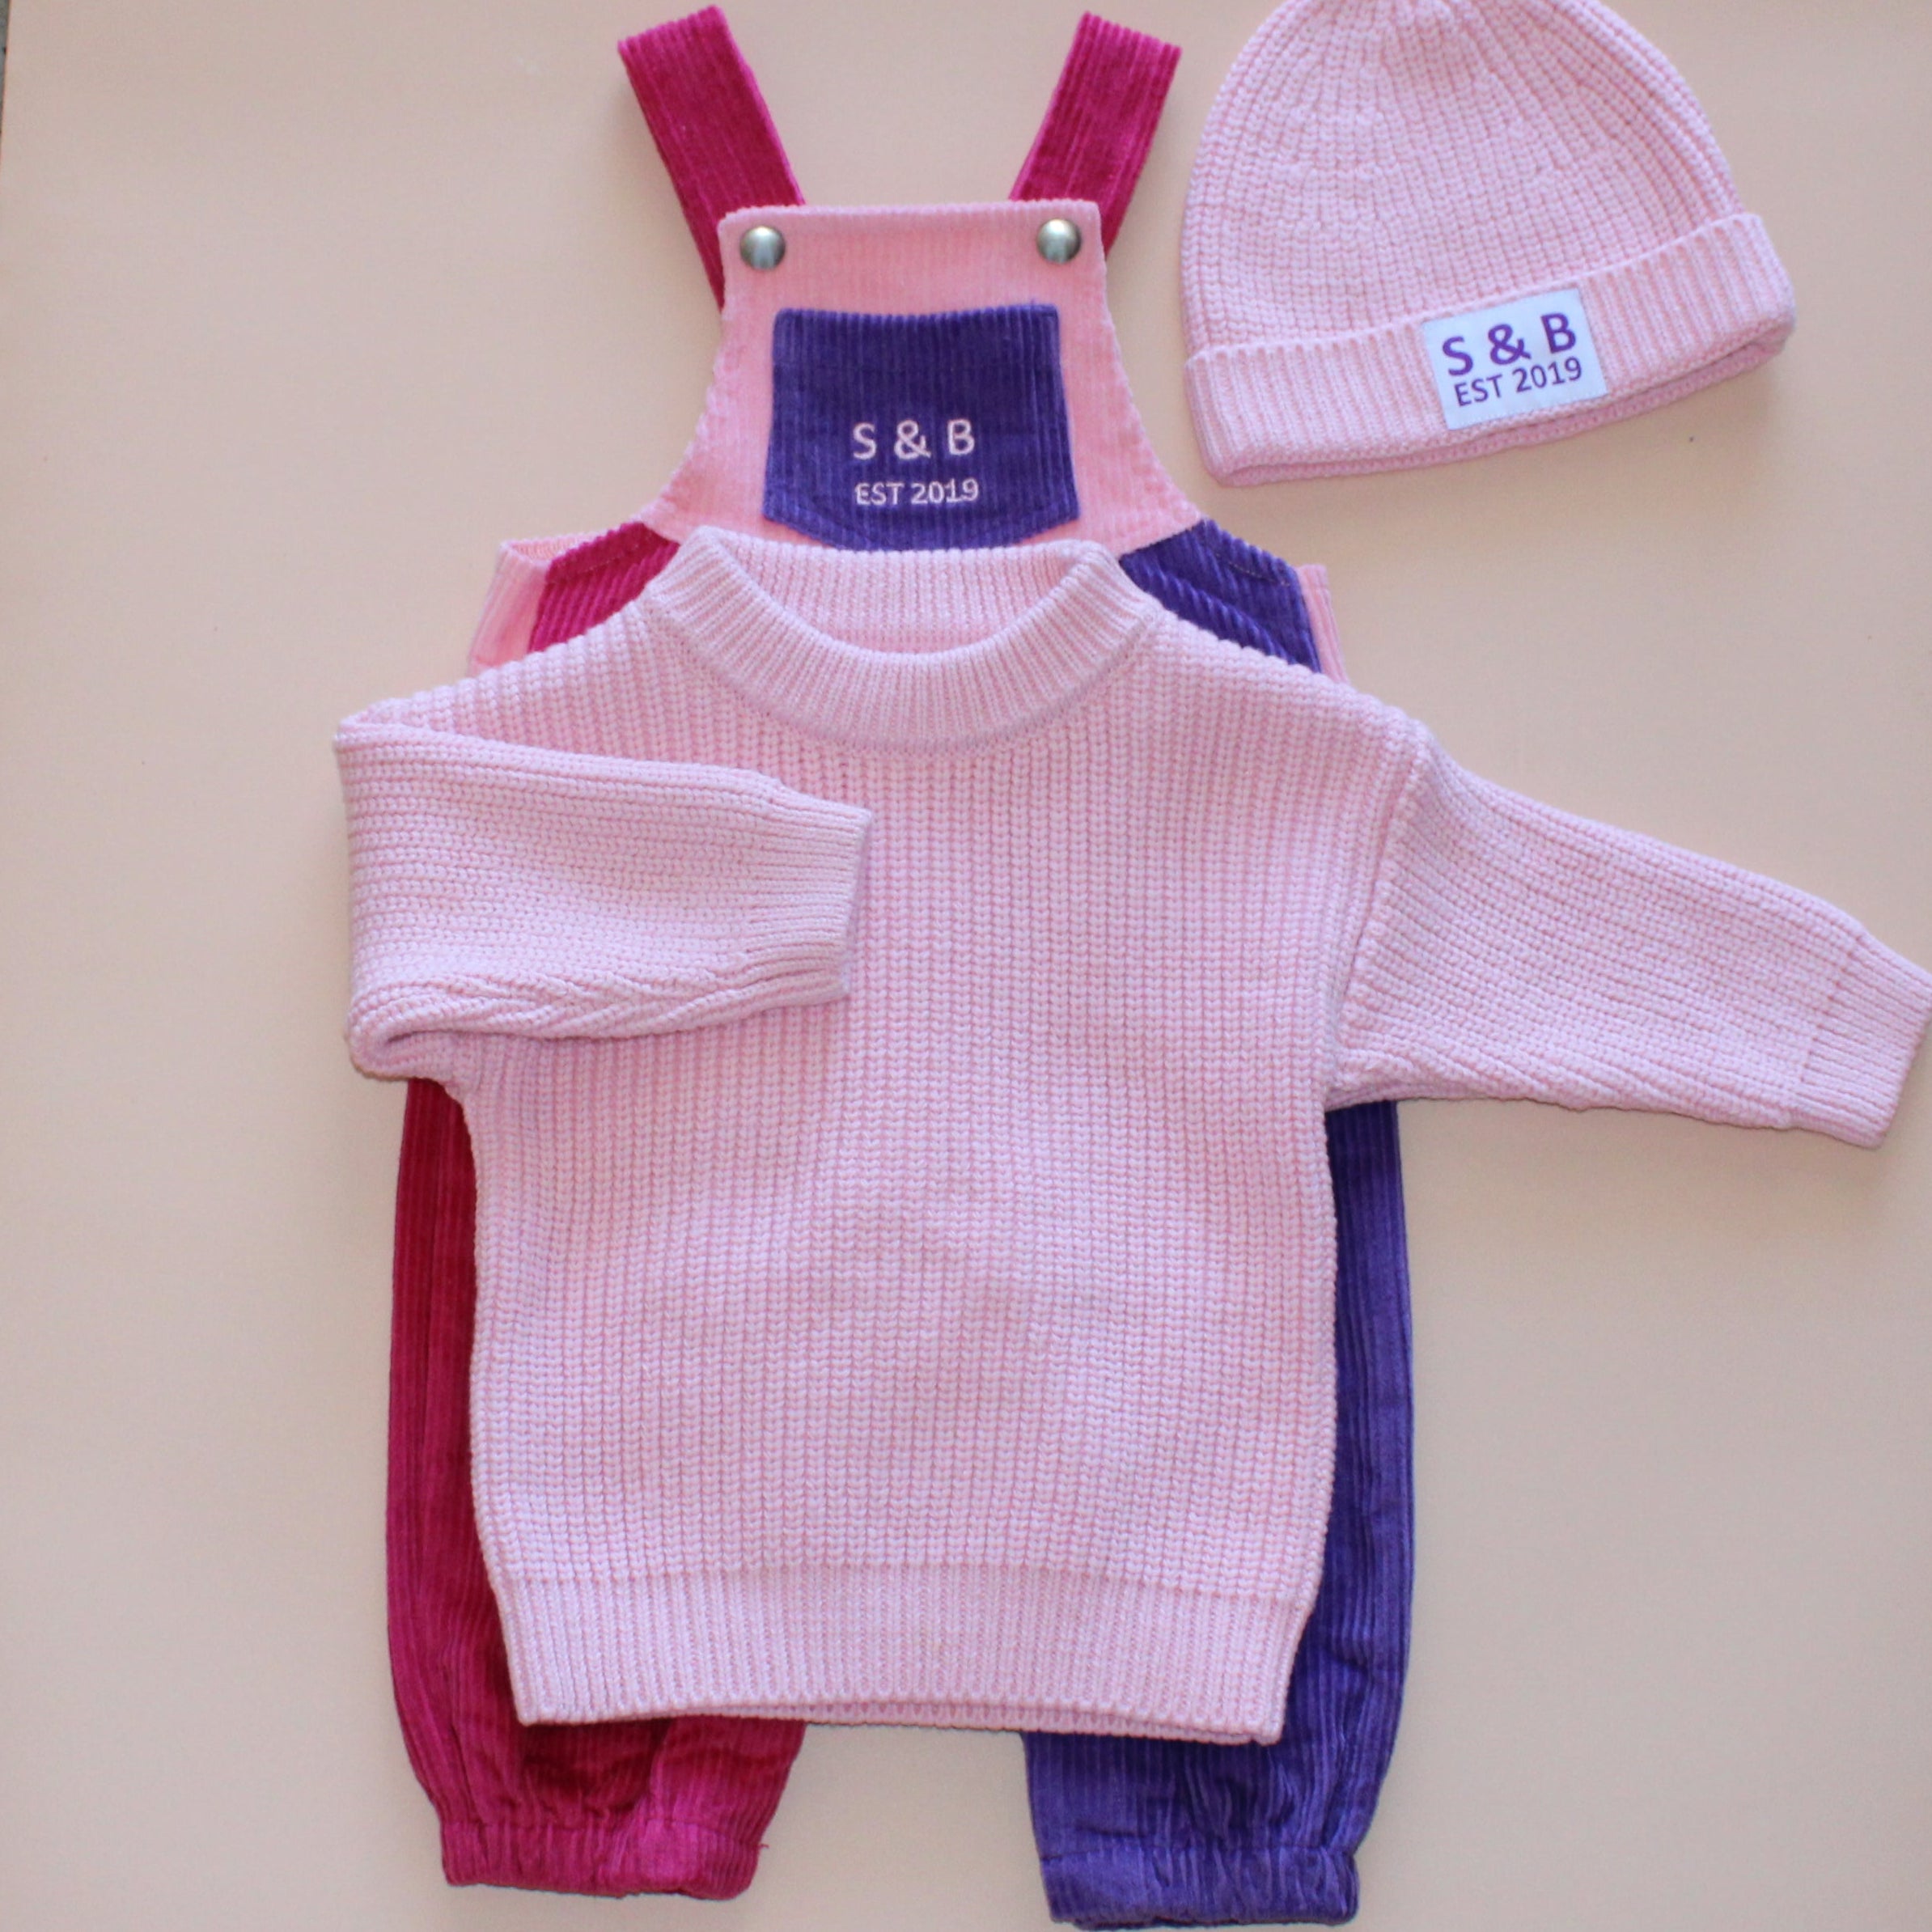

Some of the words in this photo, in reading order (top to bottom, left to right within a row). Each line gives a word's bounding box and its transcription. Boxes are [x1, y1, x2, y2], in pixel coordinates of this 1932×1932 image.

[1442, 336, 1473, 376] S
[1487, 323, 1532, 365] &
[1540, 312, 1576, 354] B
[1454, 374, 1502, 407] EST
[1511, 356, 1582, 393] 2019
[853, 422, 877, 460] S
[894, 420, 930, 460] &
[947, 419, 975, 455] B
[854, 482, 905, 506] EST
[910, 478, 979, 505] 2019
